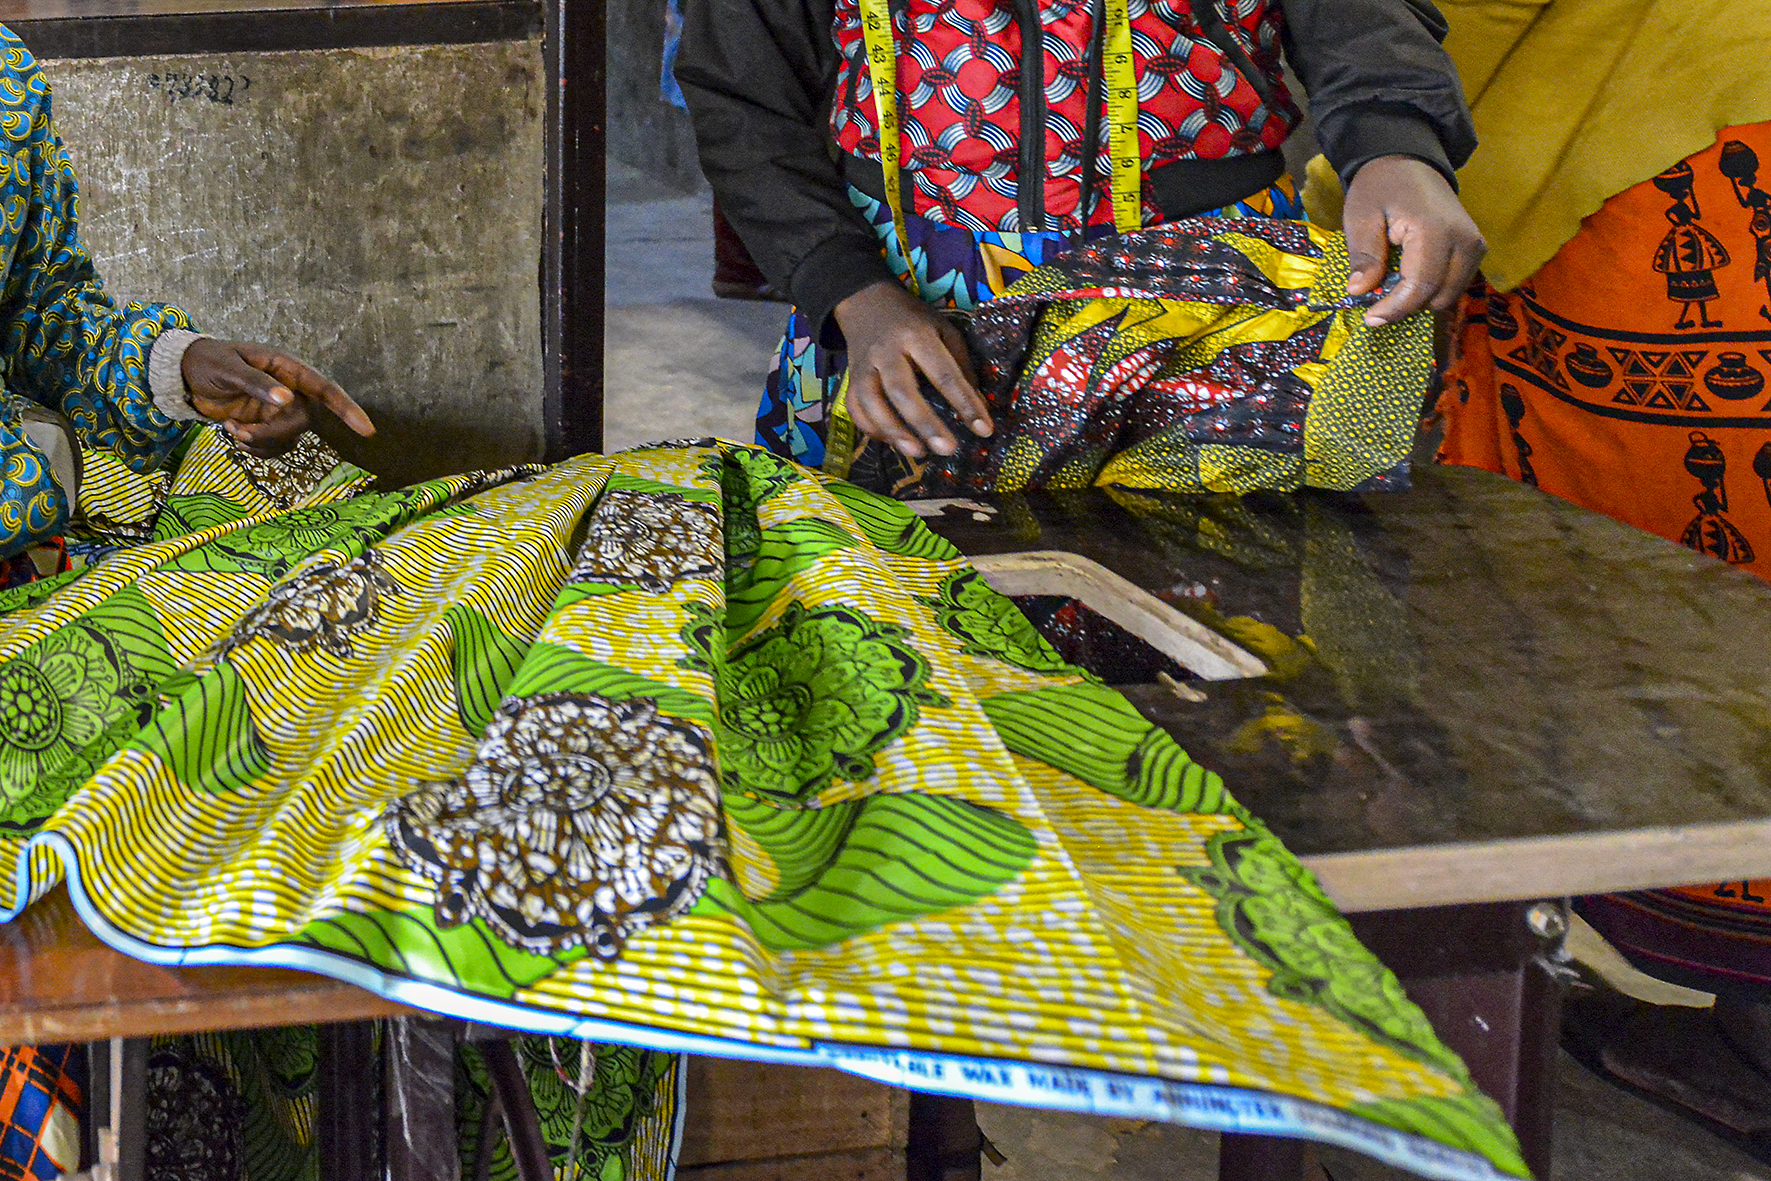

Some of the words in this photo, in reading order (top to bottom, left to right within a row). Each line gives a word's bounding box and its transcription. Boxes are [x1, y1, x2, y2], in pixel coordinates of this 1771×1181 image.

[866, 10, 882, 32] 42
[871, 43, 888, 65] 43
[876, 76, 892, 97] 44
[1118, 88, 1133, 100] 8
[1120, 123, 1134, 135] 7
[1121, 157, 1135, 169] 6
